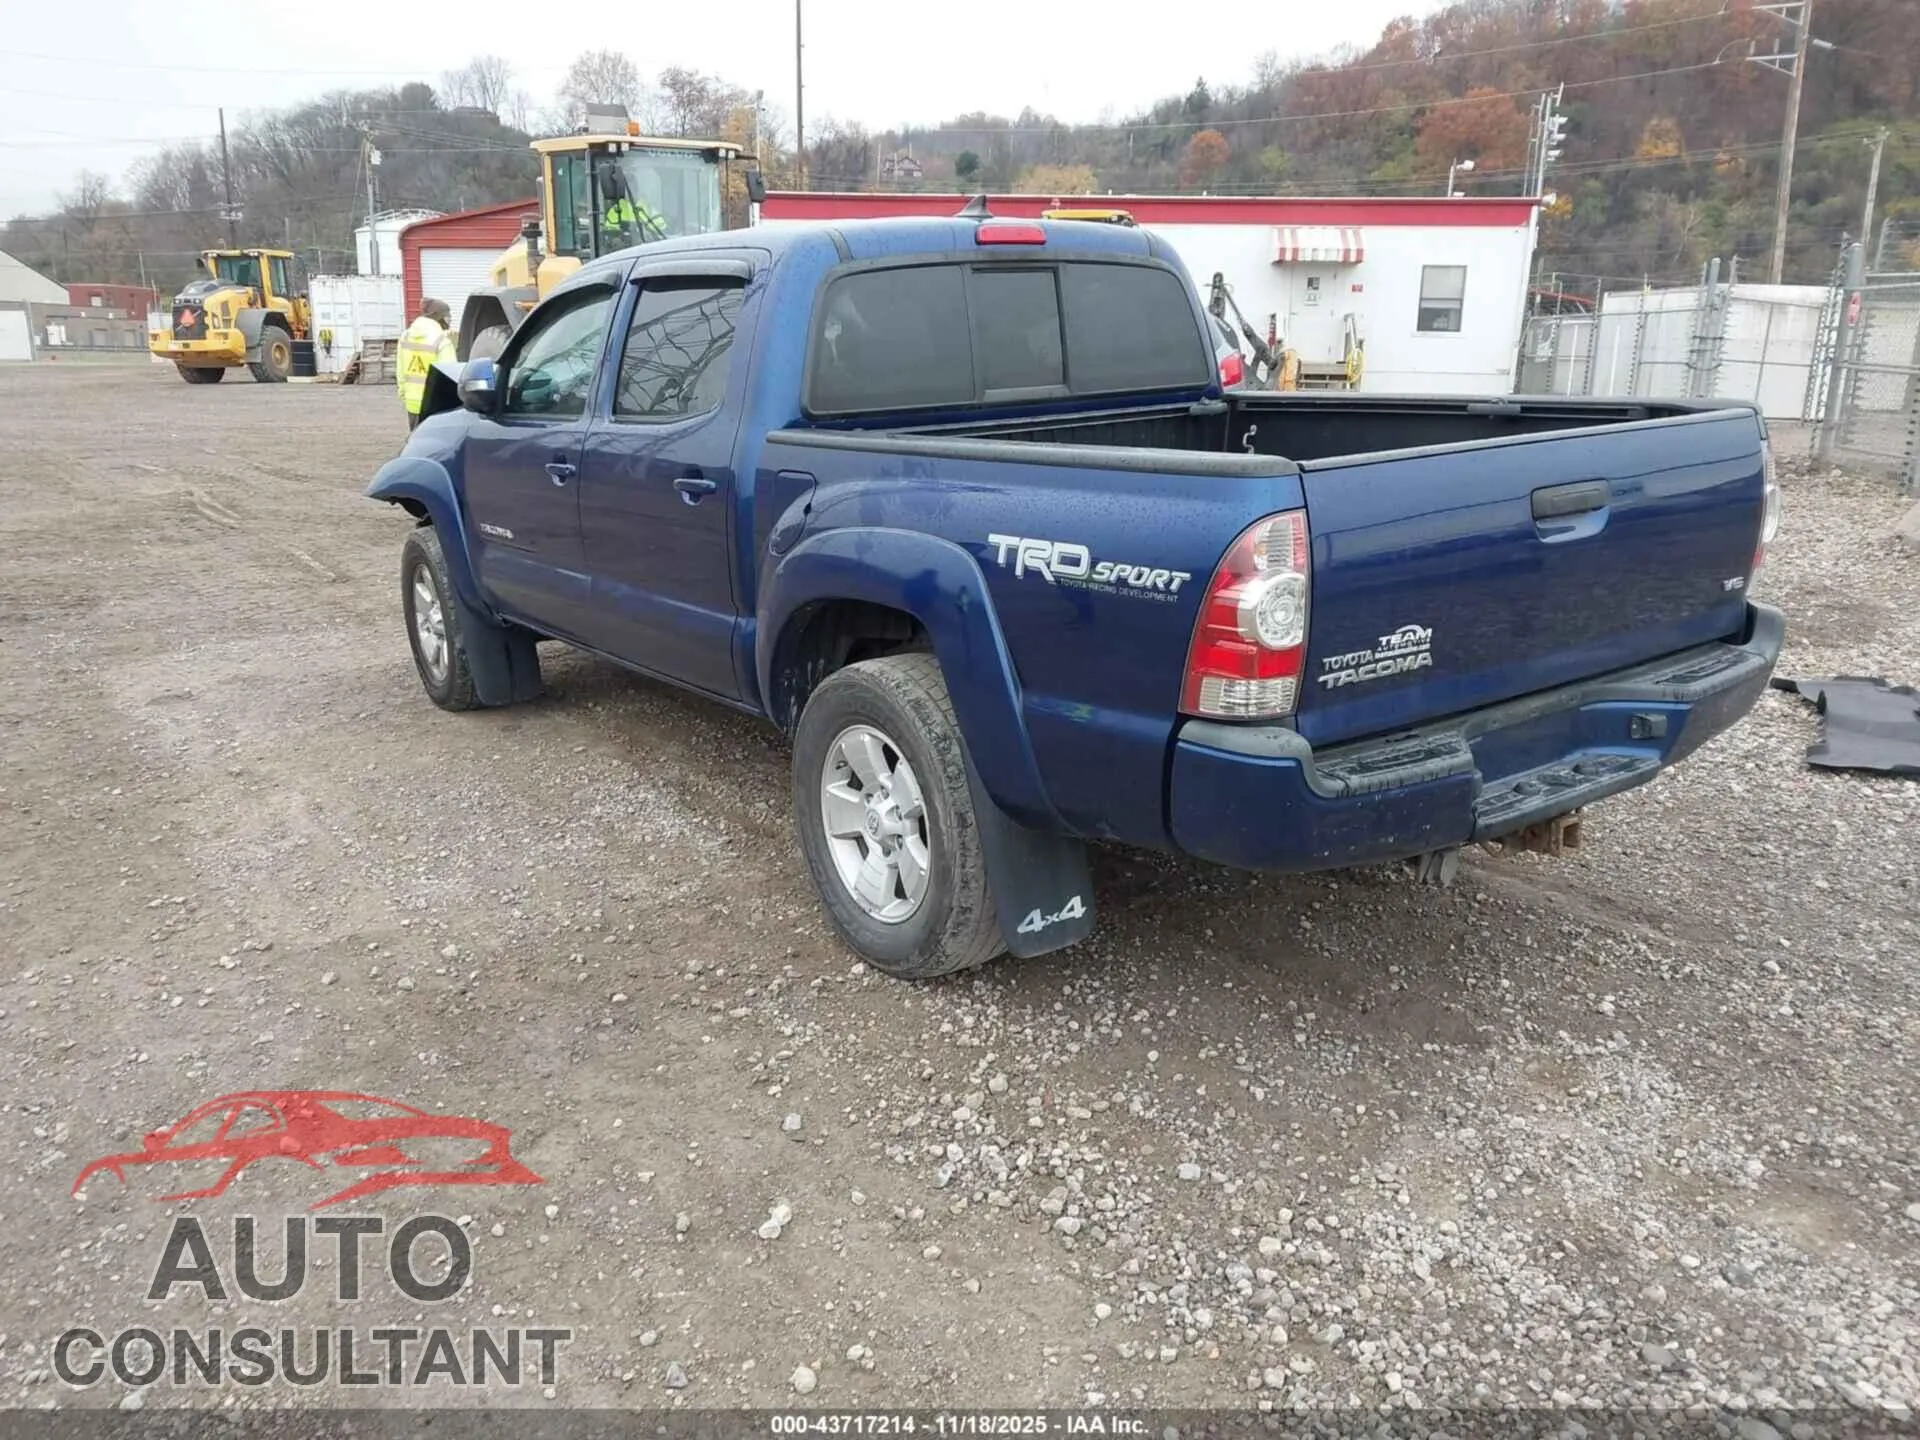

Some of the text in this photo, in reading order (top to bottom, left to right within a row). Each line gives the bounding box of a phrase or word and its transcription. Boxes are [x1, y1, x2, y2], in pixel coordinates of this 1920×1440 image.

[987, 532, 1192, 593] TRD SPORT
[1118, 587, 1178, 602] DEVELOPMENT
[1378, 628, 1432, 645] TEAM
[1317, 652, 1433, 689] TACOMA
[1322, 650, 1374, 670] TOYOTA
[1016, 895, 1087, 934] 4x4
